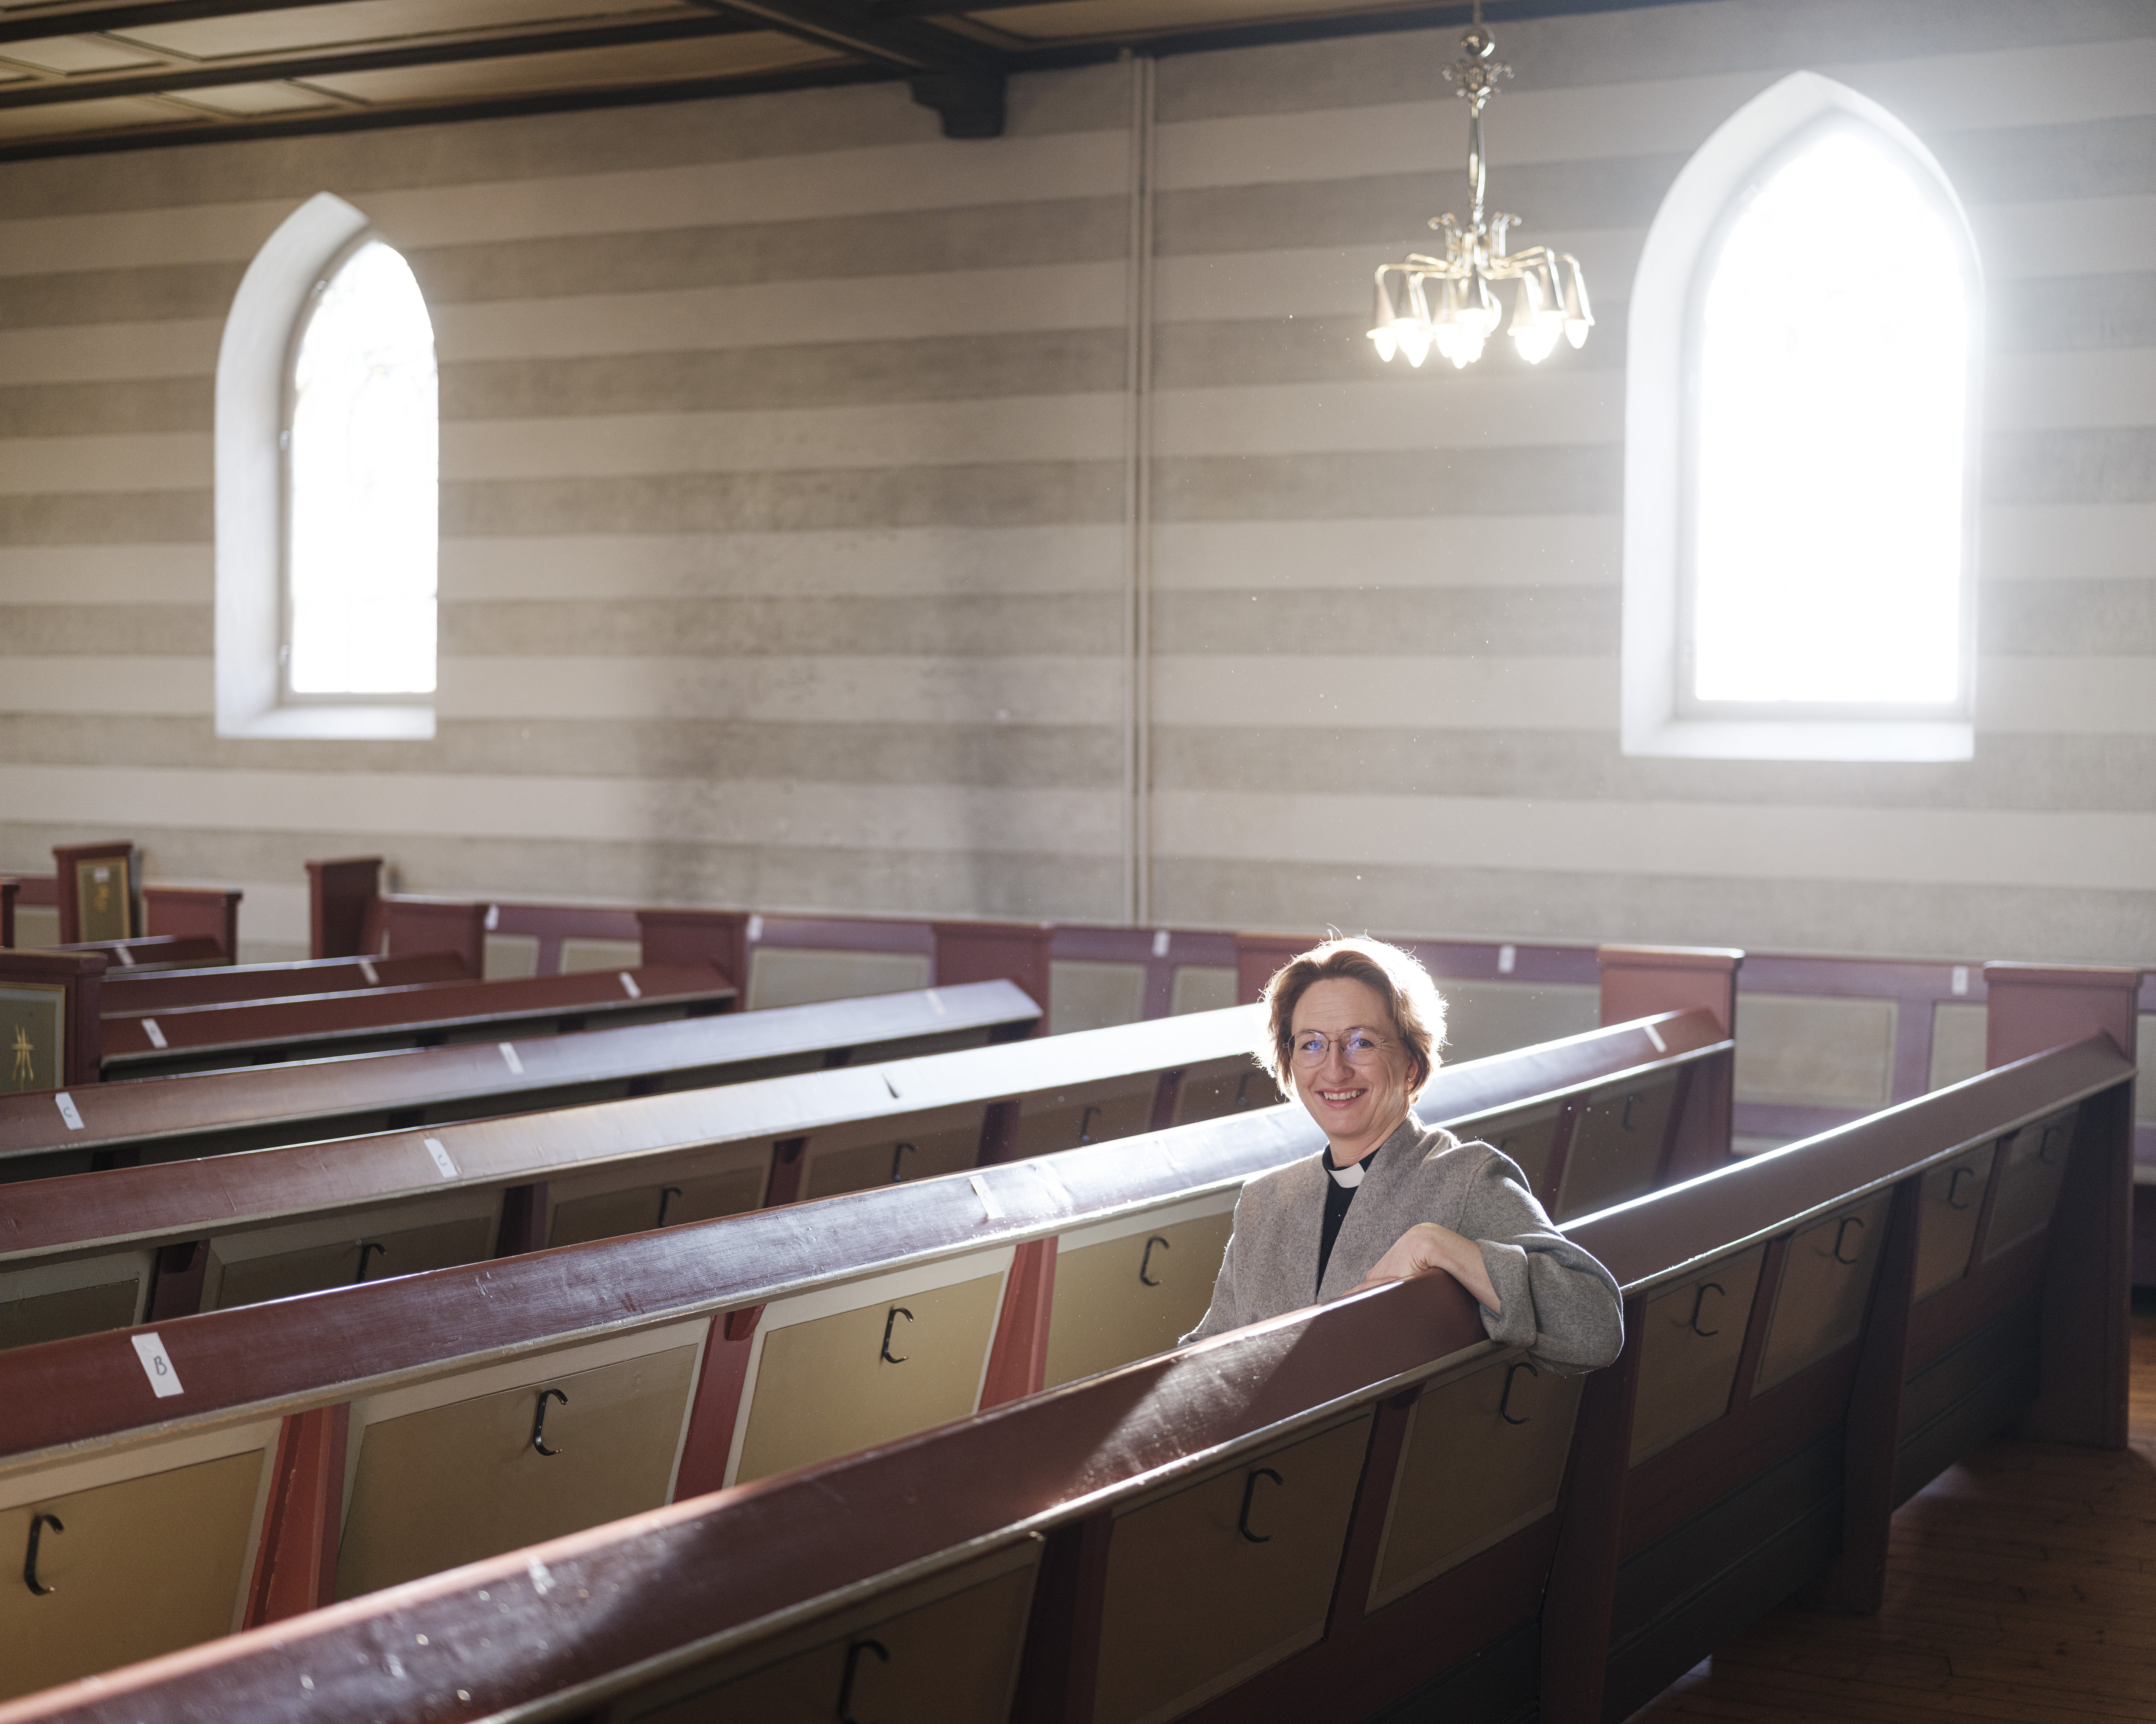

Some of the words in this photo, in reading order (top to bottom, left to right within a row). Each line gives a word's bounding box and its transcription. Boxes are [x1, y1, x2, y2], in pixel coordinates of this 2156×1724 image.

[63, 1106, 72, 1118] C
[438, 1154, 447, 1166] C
[154, 1356, 167, 1376] B
